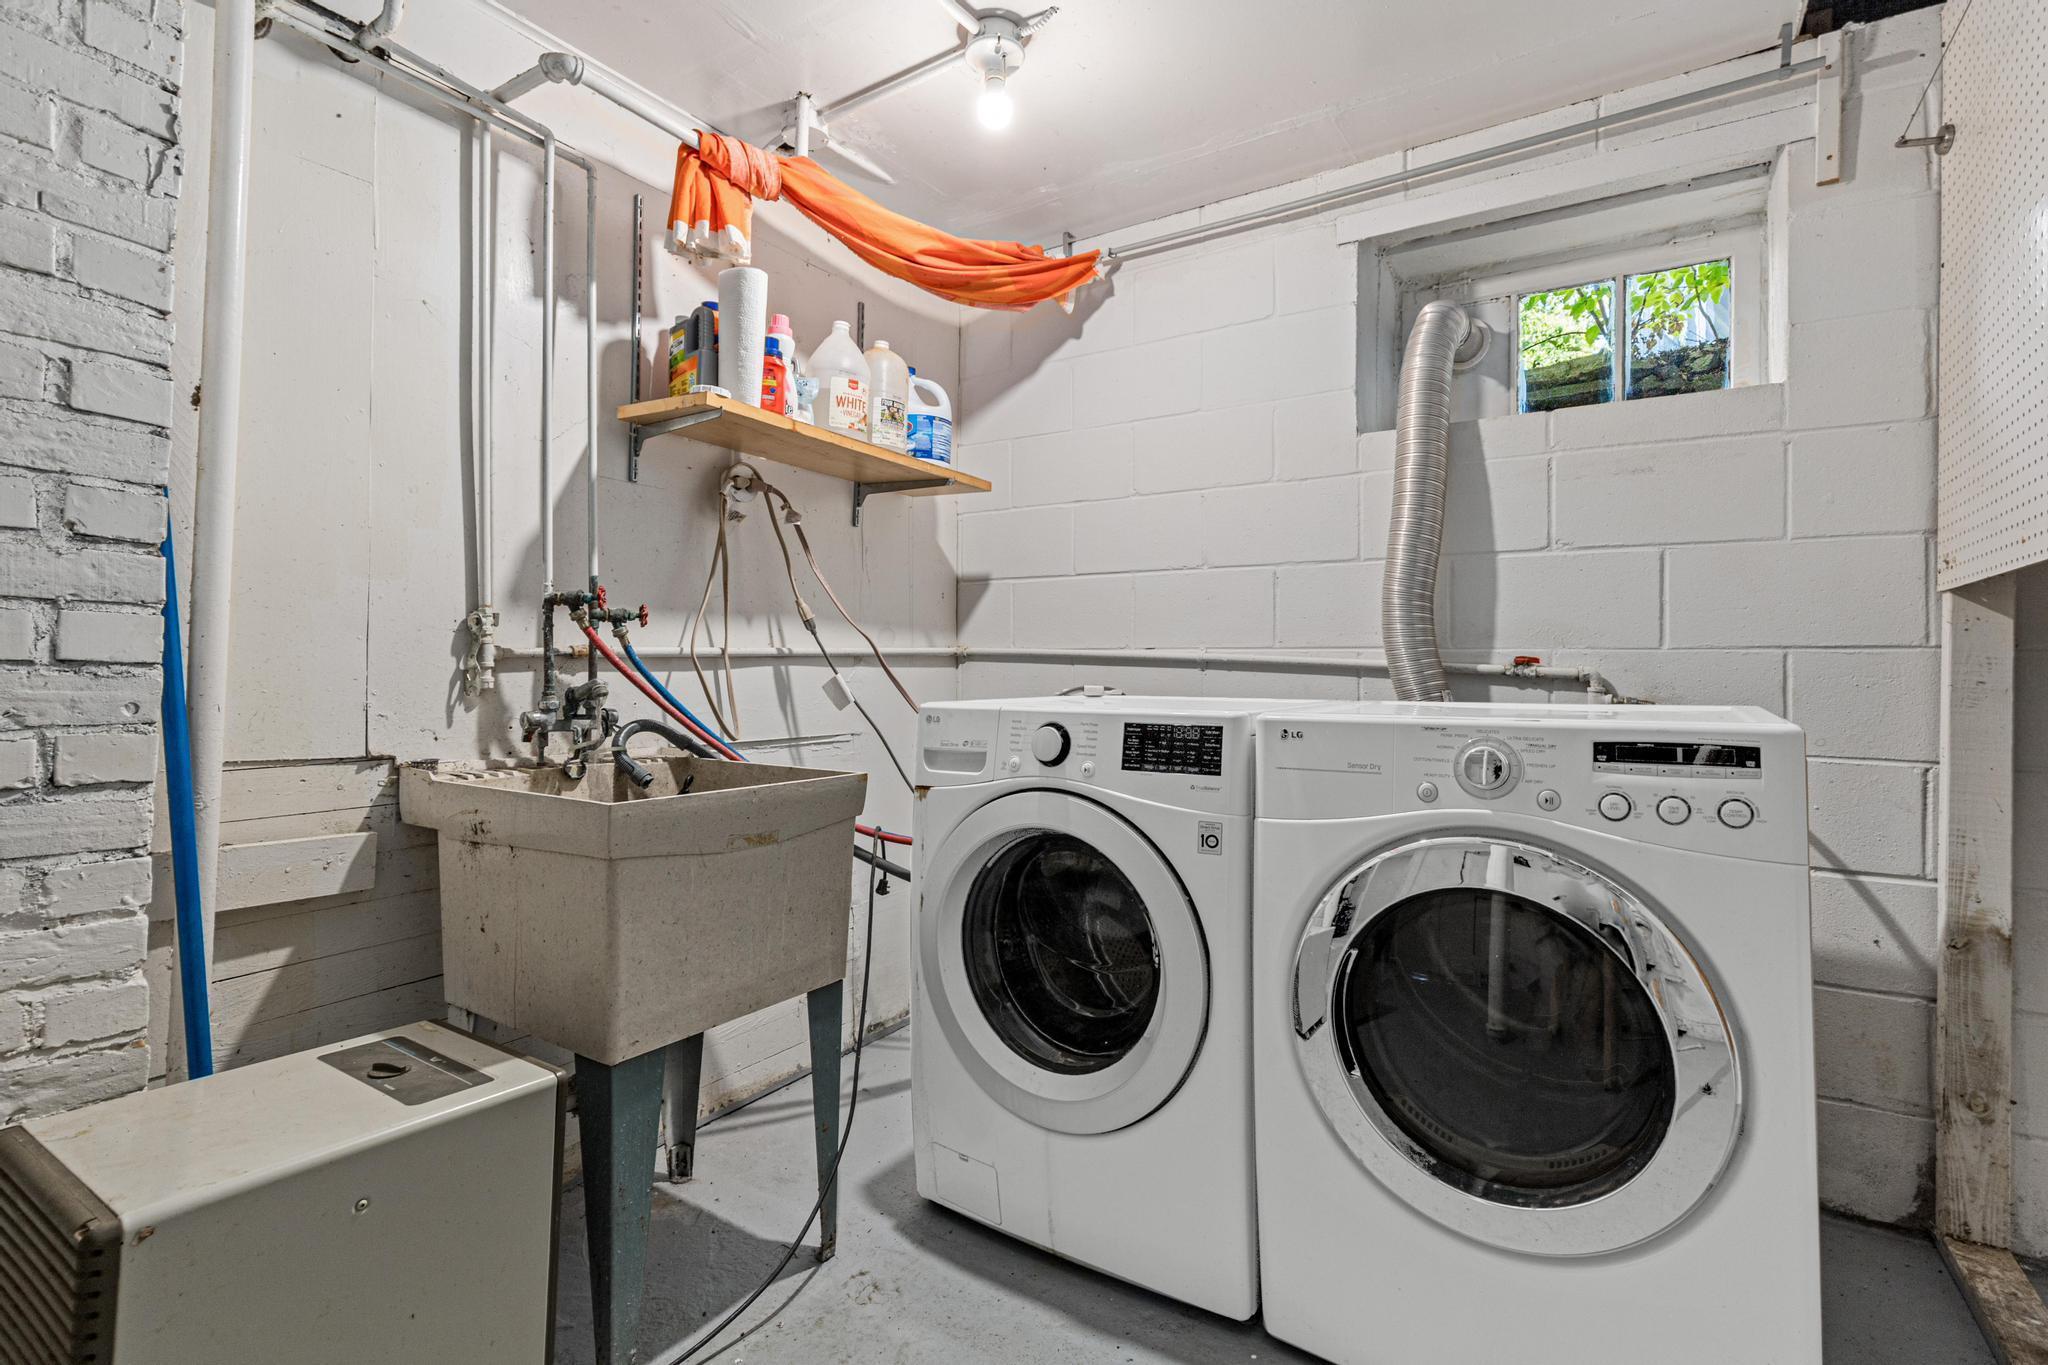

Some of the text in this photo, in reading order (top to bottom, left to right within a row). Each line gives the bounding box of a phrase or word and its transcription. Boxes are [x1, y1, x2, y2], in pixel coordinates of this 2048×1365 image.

[836, 395, 867, 412] WHITE
[1291, 730, 1303, 739] LG
[1369, 763, 1381, 771] Dry
[1200, 833, 1219, 849] 10
